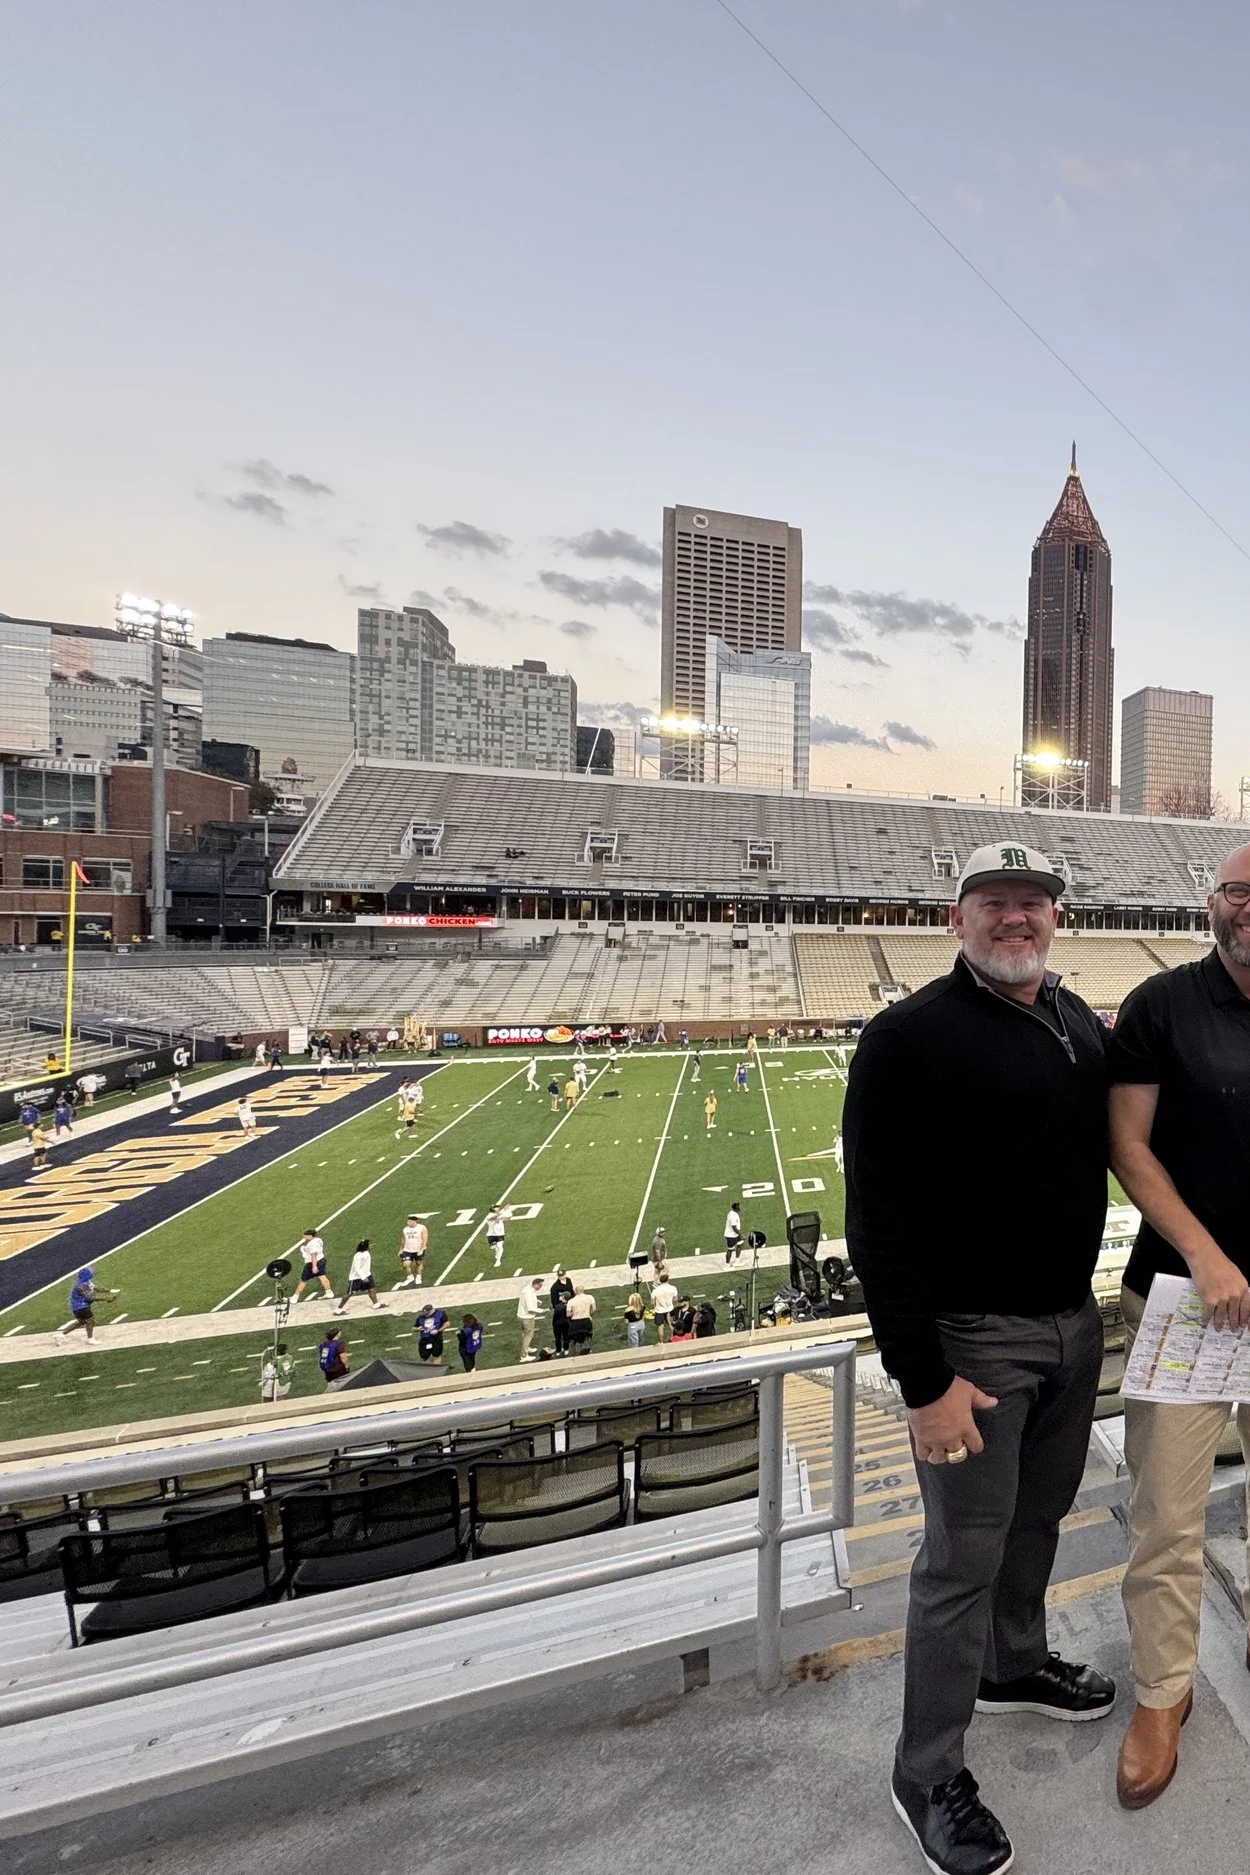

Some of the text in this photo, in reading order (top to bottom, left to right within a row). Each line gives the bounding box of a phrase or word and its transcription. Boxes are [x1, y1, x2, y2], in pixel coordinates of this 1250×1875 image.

[385, 917, 427, 925] PONKO
[488, 1028, 543, 1039] PONKO
[173, 1047, 191, 1067] GT
[742, 1177, 826, 1198] 20
[863, 1475, 902, 1493] 26
[880, 1496, 921, 1517] 27
